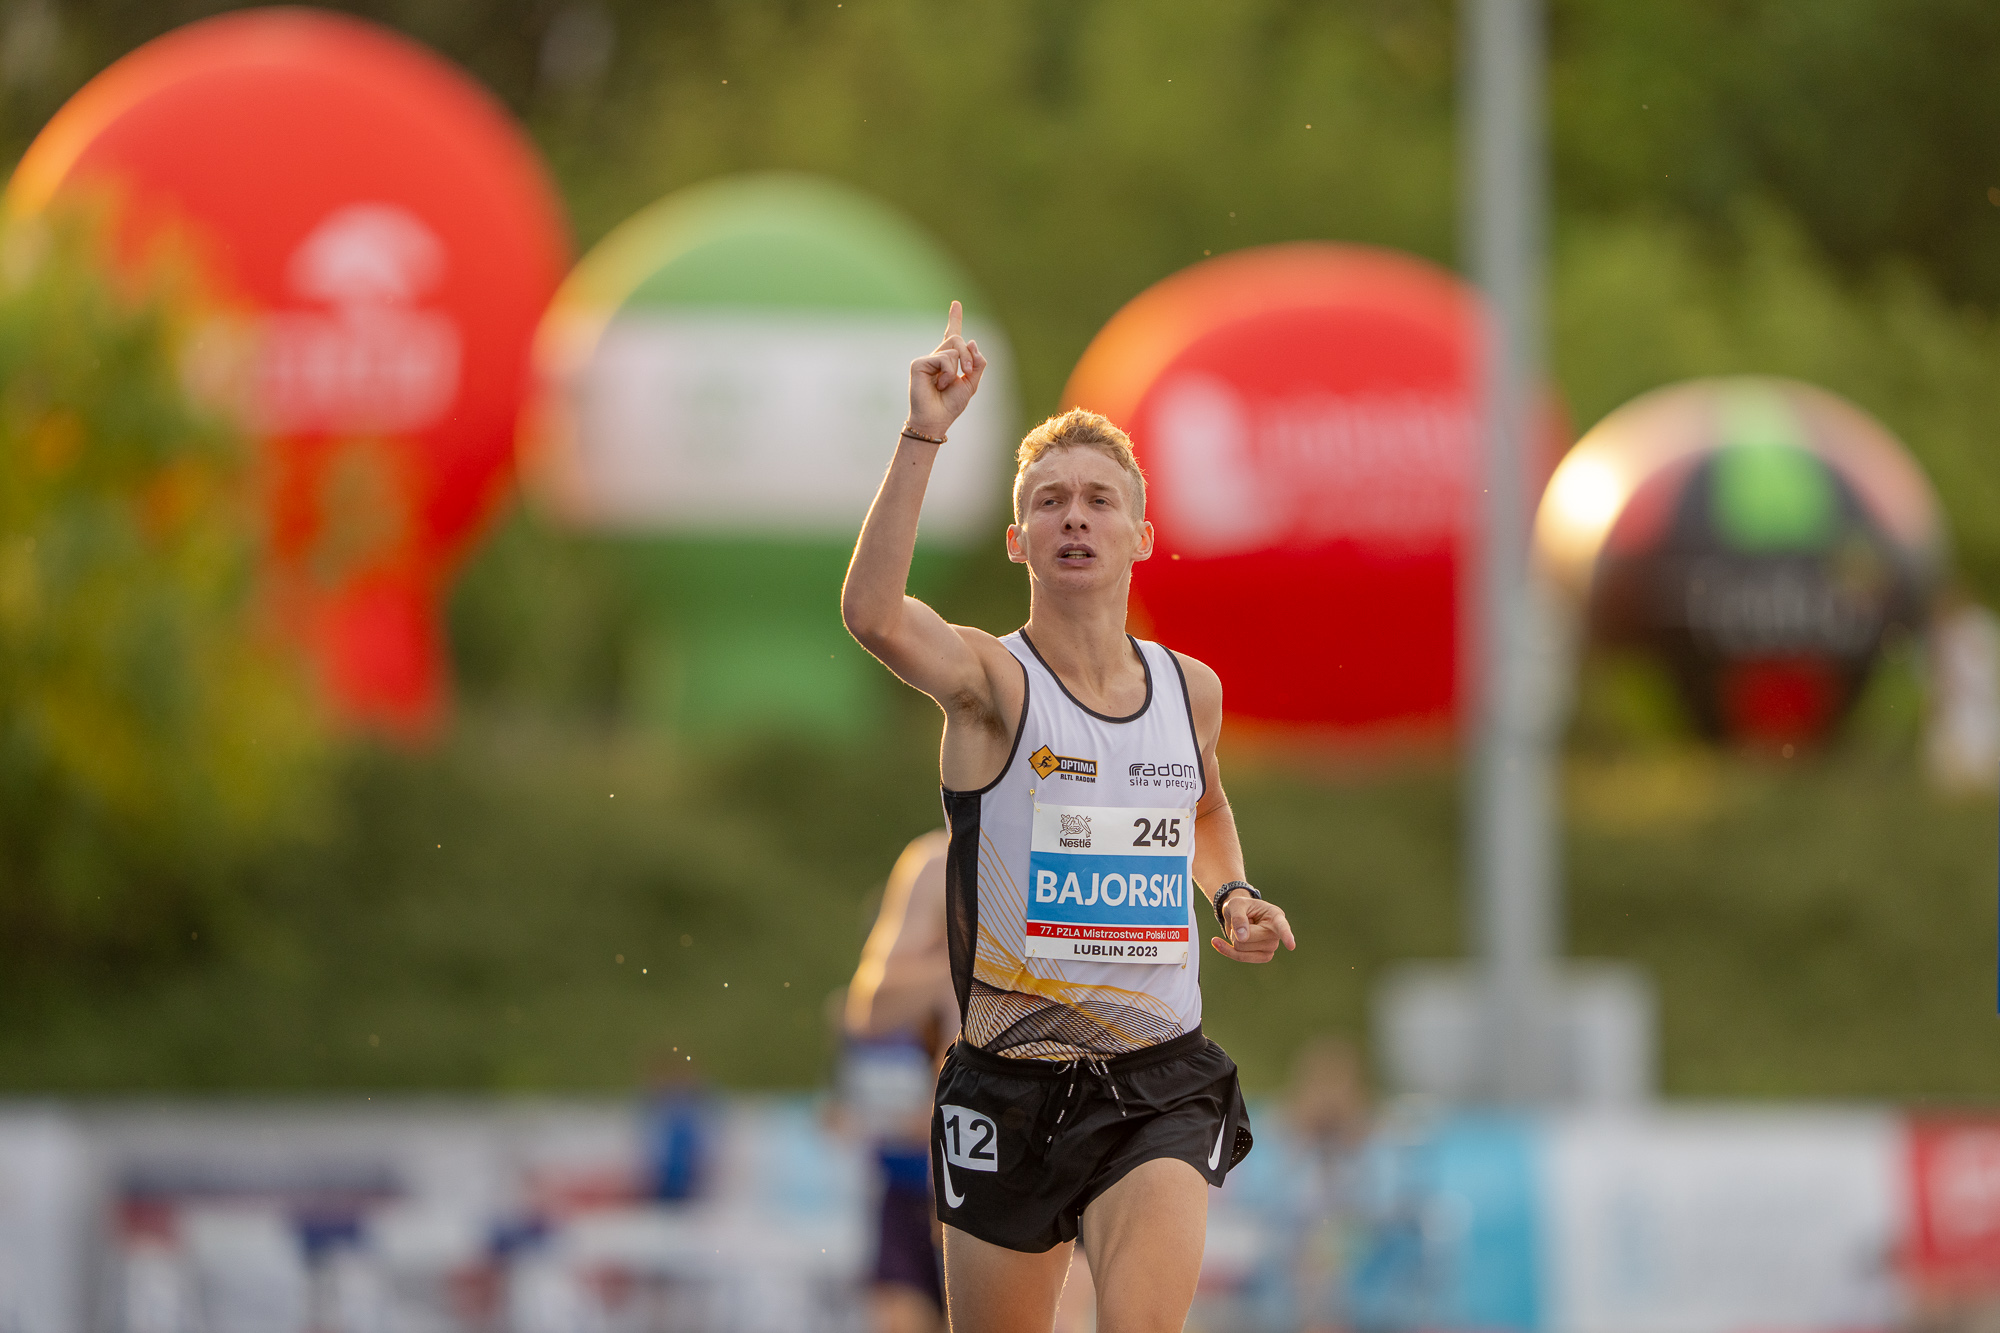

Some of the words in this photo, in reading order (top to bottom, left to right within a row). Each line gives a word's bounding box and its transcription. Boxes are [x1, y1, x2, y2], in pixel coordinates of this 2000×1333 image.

[1060, 759, 1096, 774] OPTIMA
[1060, 774, 1073, 782] RLTL
[1075, 775, 1096, 783] RADOM
[1130, 777, 1149, 786] siła
[1132, 817, 1180, 848] 245
[1059, 837, 1092, 848] Nestlé
[1035, 869, 1182, 908] BAJORSKI
[1039, 925, 1054, 936] 77.
[1056, 927, 1080, 938] PZLA
[1083, 928, 1144, 940] Mistrzostwa
[1145, 930, 1166, 940] Polski
[1167, 931, 1180, 940] U20
[1073, 944, 1124, 957] LUBLIN
[1127, 945, 1158, 957] 2023
[945, 1114, 996, 1161] 12
